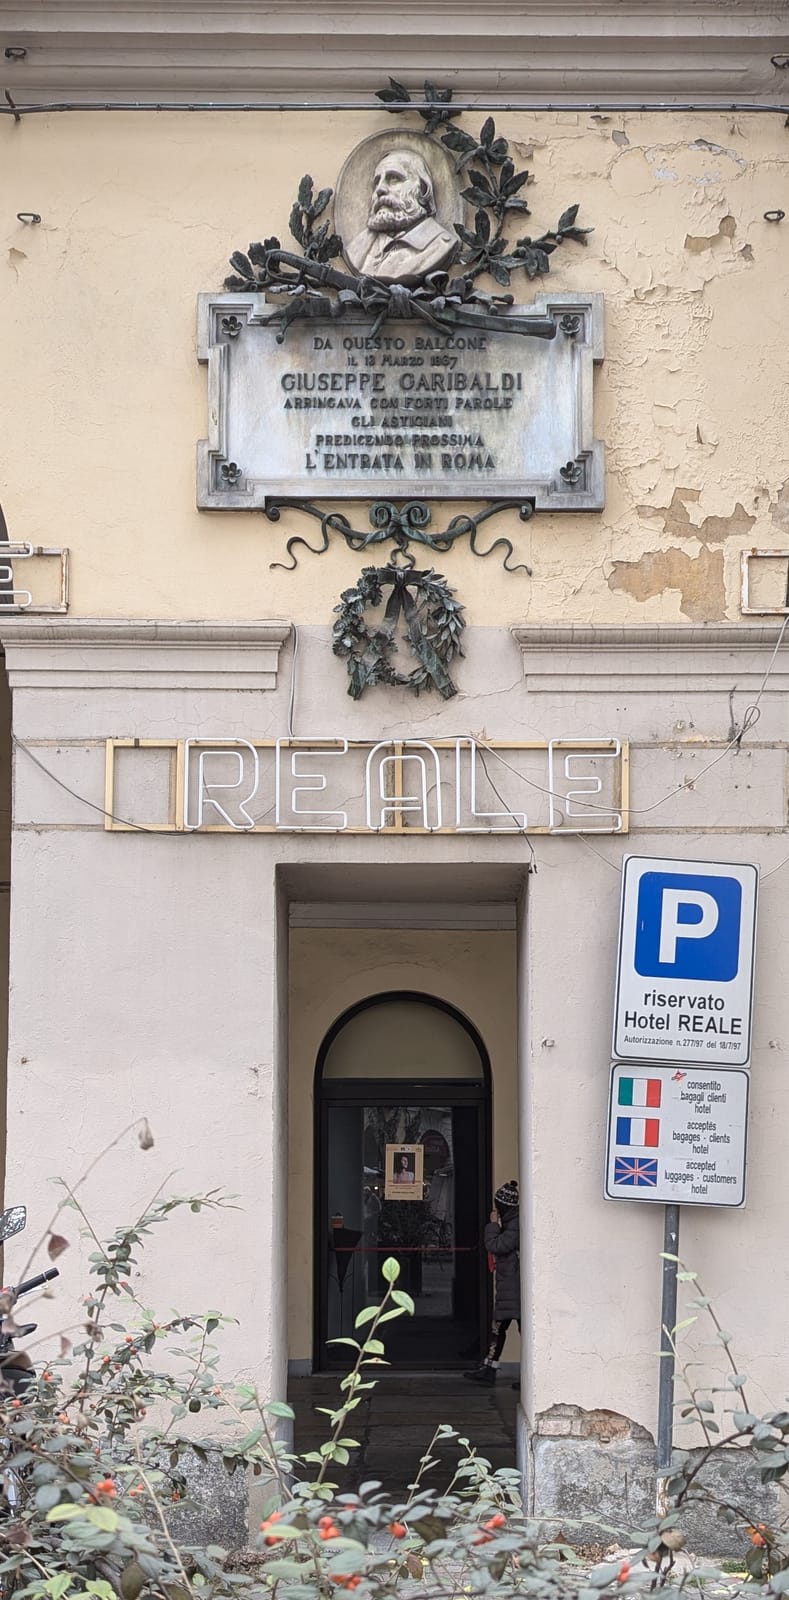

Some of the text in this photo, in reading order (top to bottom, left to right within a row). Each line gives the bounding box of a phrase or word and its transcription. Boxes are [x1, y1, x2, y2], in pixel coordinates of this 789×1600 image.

[313, 337, 487, 351] DA QUESTO BALCONE
[431, 355, 458, 369] 1867
[281, 373, 523, 391] GIUSEPPE GARIBALDI
[283, 398, 513, 409] ARRINGAVA CON FORTI PAROLE
[351, 416, 452, 428] GLI ASTIGIANI
[315, 434, 484, 447] PREDICENDO PROSSIMA
[306, 449, 496, 470] L'ENTRATA IN ROMA
[184, 738, 622, 834] REALE
[658, 888, 720, 964] P
[643, 989, 725, 1011] riservato
[624, 1011, 742, 1035] Hotel REALE
[624, 1035, 673, 1046] Autorizzazione
[706, 1041, 717, 1049] del
[719, 1041, 742, 1051] 18/7/97
[687, 1081, 721, 1091] consentito
[680, 1091, 727, 1104] bagagli clienti
[694, 1104, 711, 1114] hotel
[672, 1131, 700, 1144] bagages
[709, 1134, 730, 1144] clients
[692, 1144, 709, 1154] hotel
[686, 1160, 716, 1172] accepted
[664, 1170, 694, 1183] luggages
[702, 1174, 737, 1184] customers
[691, 1184, 708, 1194] hotel
